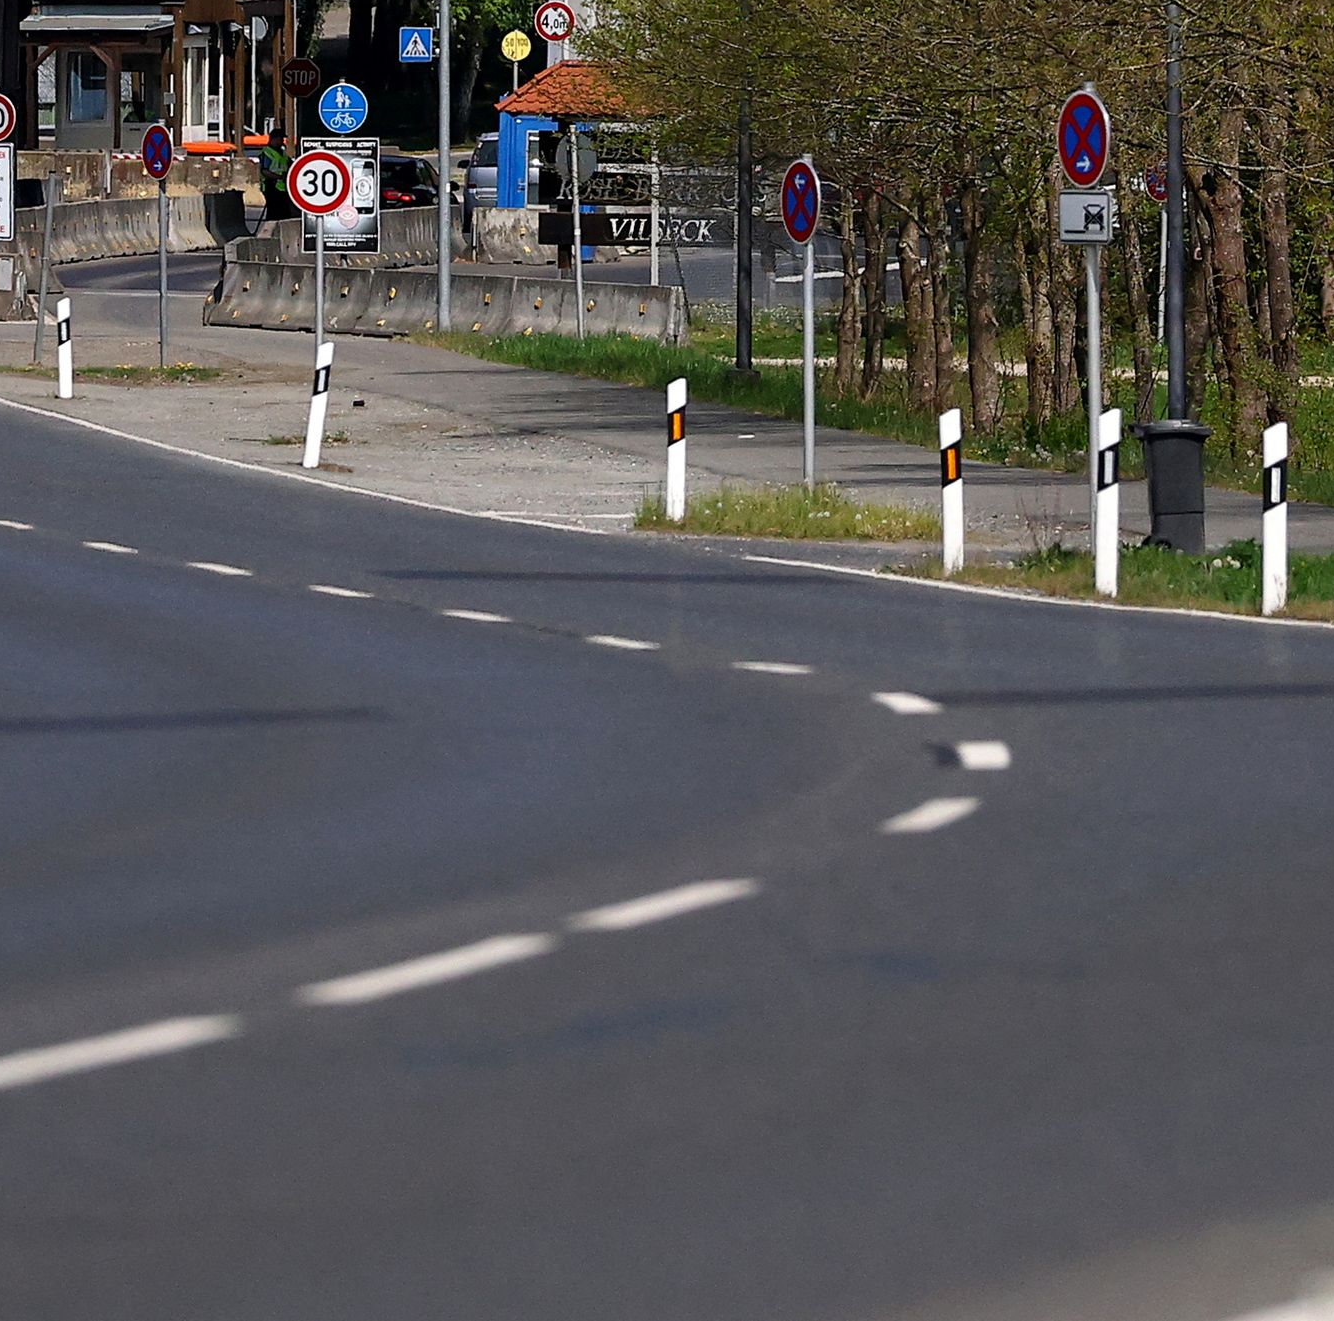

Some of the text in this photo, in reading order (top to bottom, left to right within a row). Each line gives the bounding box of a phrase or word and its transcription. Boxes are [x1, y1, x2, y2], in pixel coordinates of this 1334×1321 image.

[541, 14, 568, 31] 4,0m
[284, 70, 316, 86] STOP
[302, 169, 337, 197] 30
[609, 218, 717, 242] VILSECK
